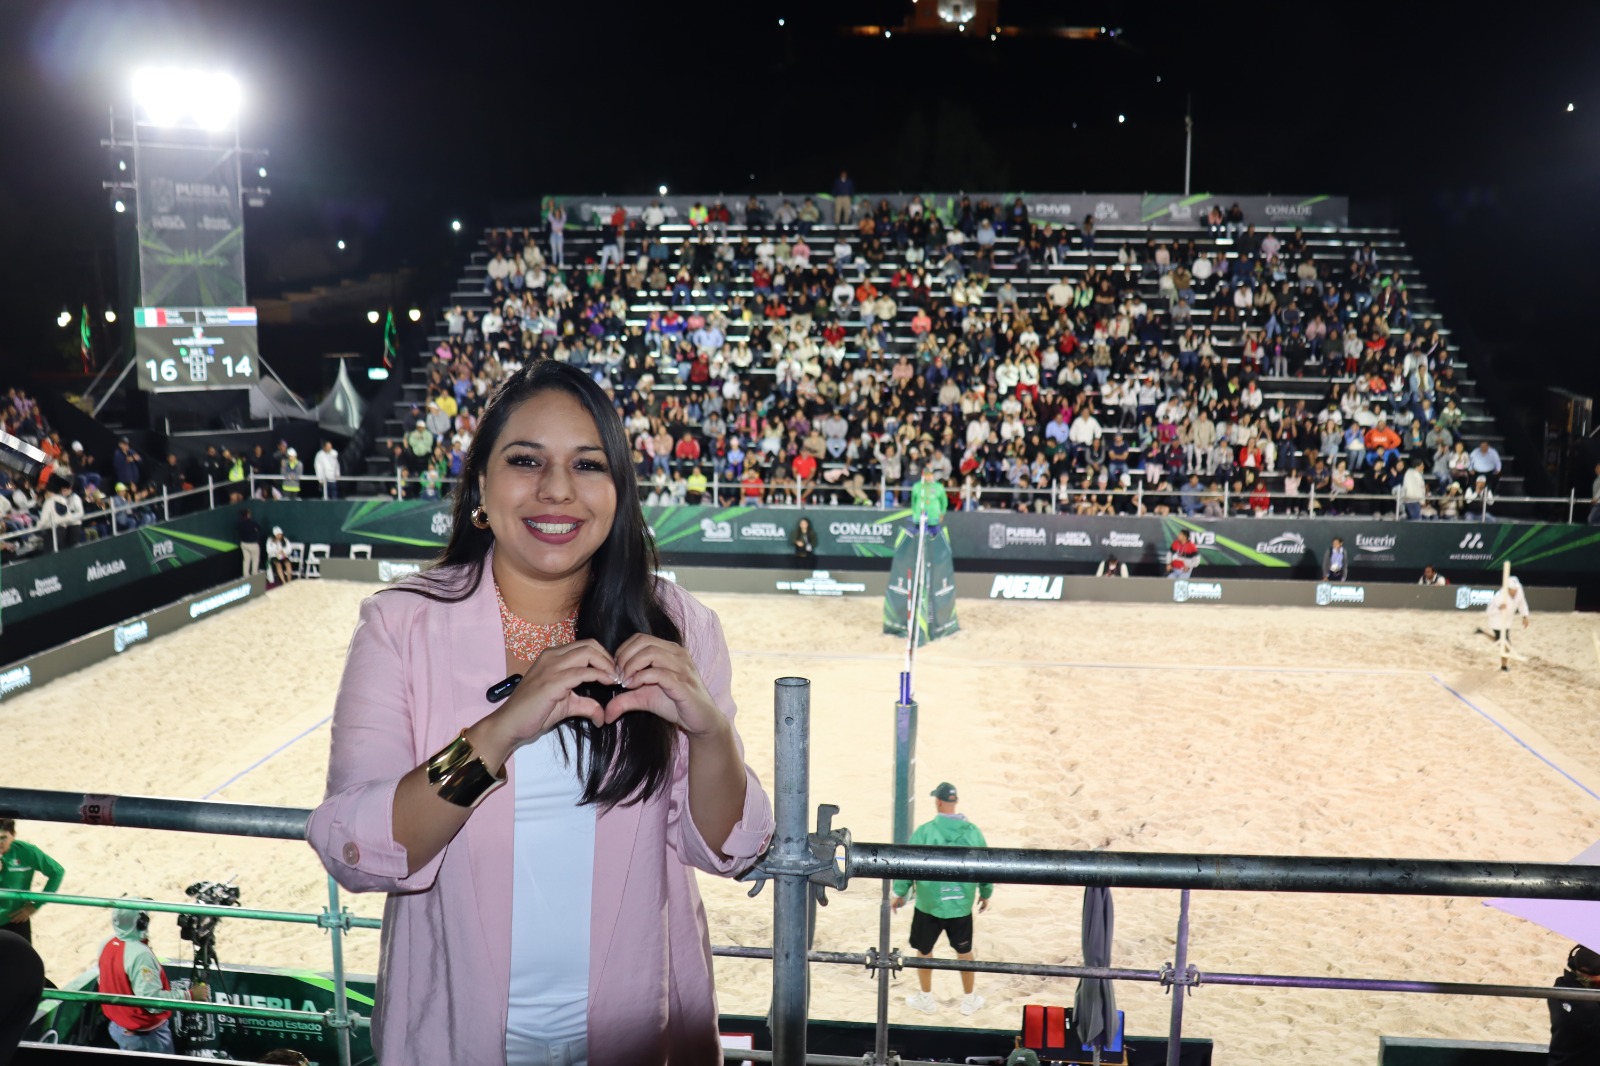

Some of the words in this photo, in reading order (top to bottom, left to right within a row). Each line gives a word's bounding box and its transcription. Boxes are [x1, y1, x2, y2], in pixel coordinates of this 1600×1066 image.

[176, 184, 229, 197] PUEBLA
[1265, 204, 1312, 216] CONADE
[145, 359, 178, 381] 16
[222, 355, 252, 377] 14
[829, 522, 892, 536] CONADE
[1006, 527, 1046, 538] PUEBLA
[1190, 531, 1216, 545] IVB
[1356, 533, 1396, 546] Eucerin
[1256, 541, 1305, 554] Electrolit
[87, 559, 126, 582] MIKASA
[990, 575, 1063, 599] PUEBLA
[1188, 583, 1221, 593] PUEBLA
[1331, 587, 1364, 597] PUEBLA
[217, 1013, 266, 1028] Goierno
[267, 1018, 283, 1029] del
[285, 1020, 322, 1032] Estado
